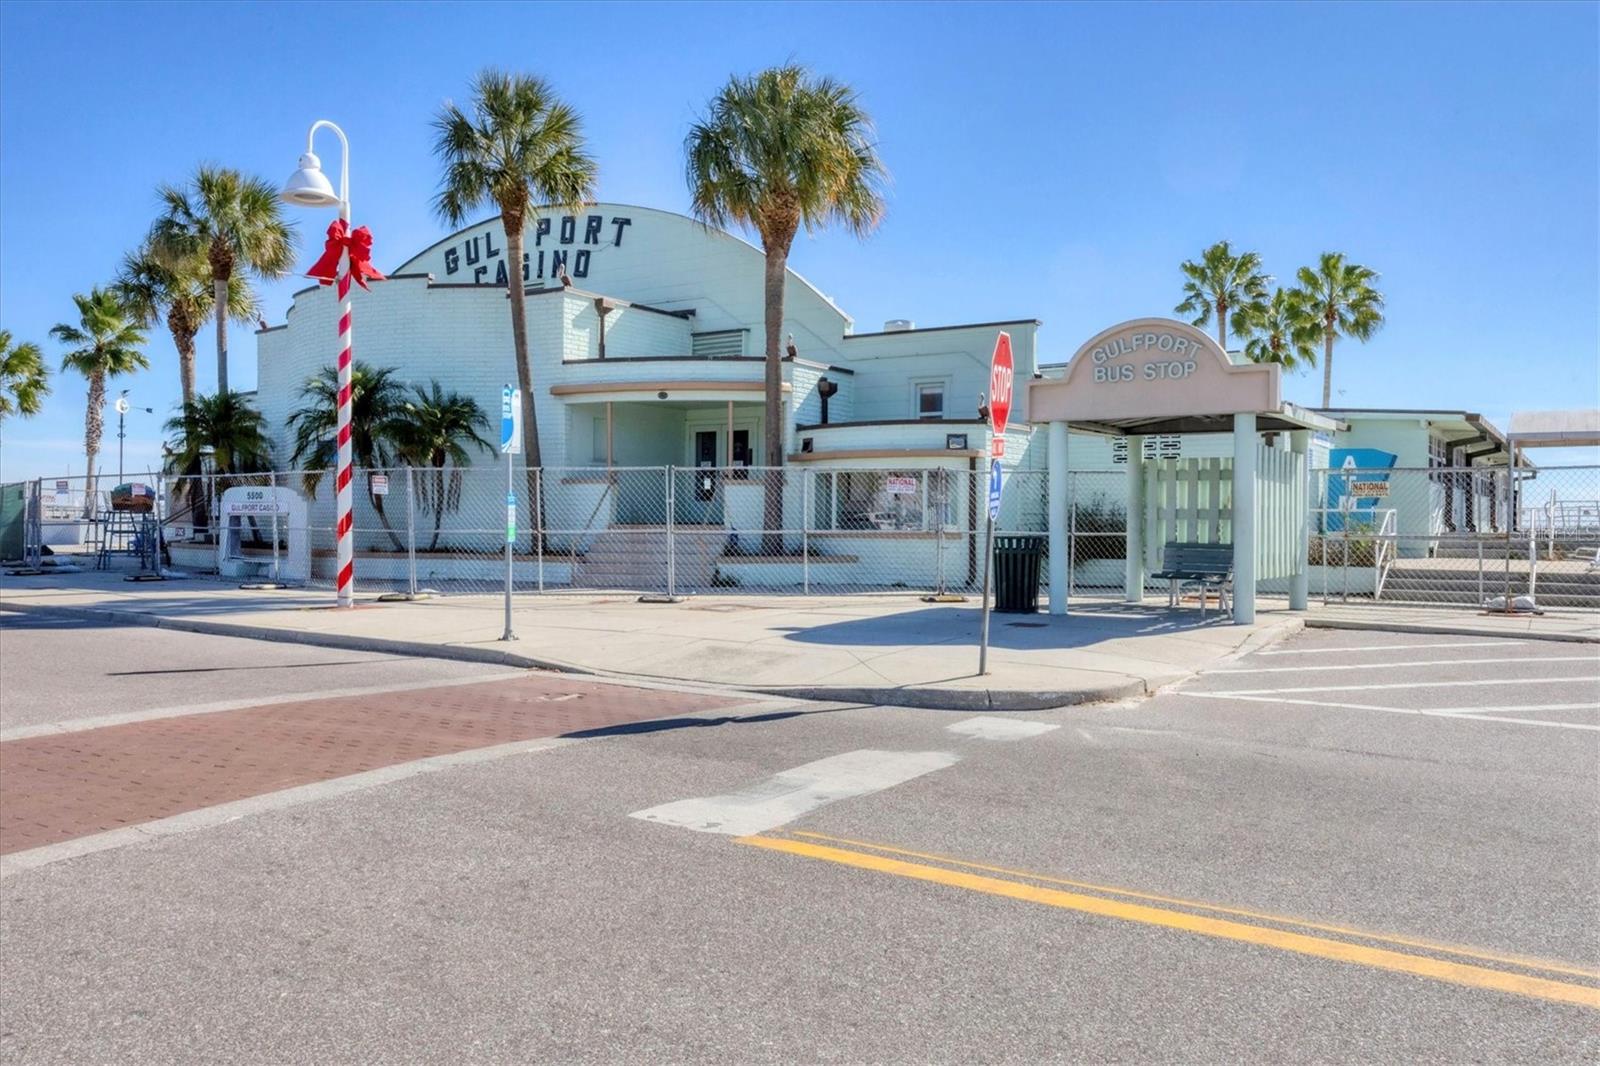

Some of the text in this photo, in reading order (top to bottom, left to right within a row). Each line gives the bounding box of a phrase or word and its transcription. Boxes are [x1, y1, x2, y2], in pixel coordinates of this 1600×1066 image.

[444, 215, 632, 276] GULPORT
[1091, 333, 1203, 364] GULFPORT
[992, 364, 1012, 403] STOP
[1094, 361, 1197, 382] BUS STOP
[1352, 482, 1387, 491] NATIONAL
